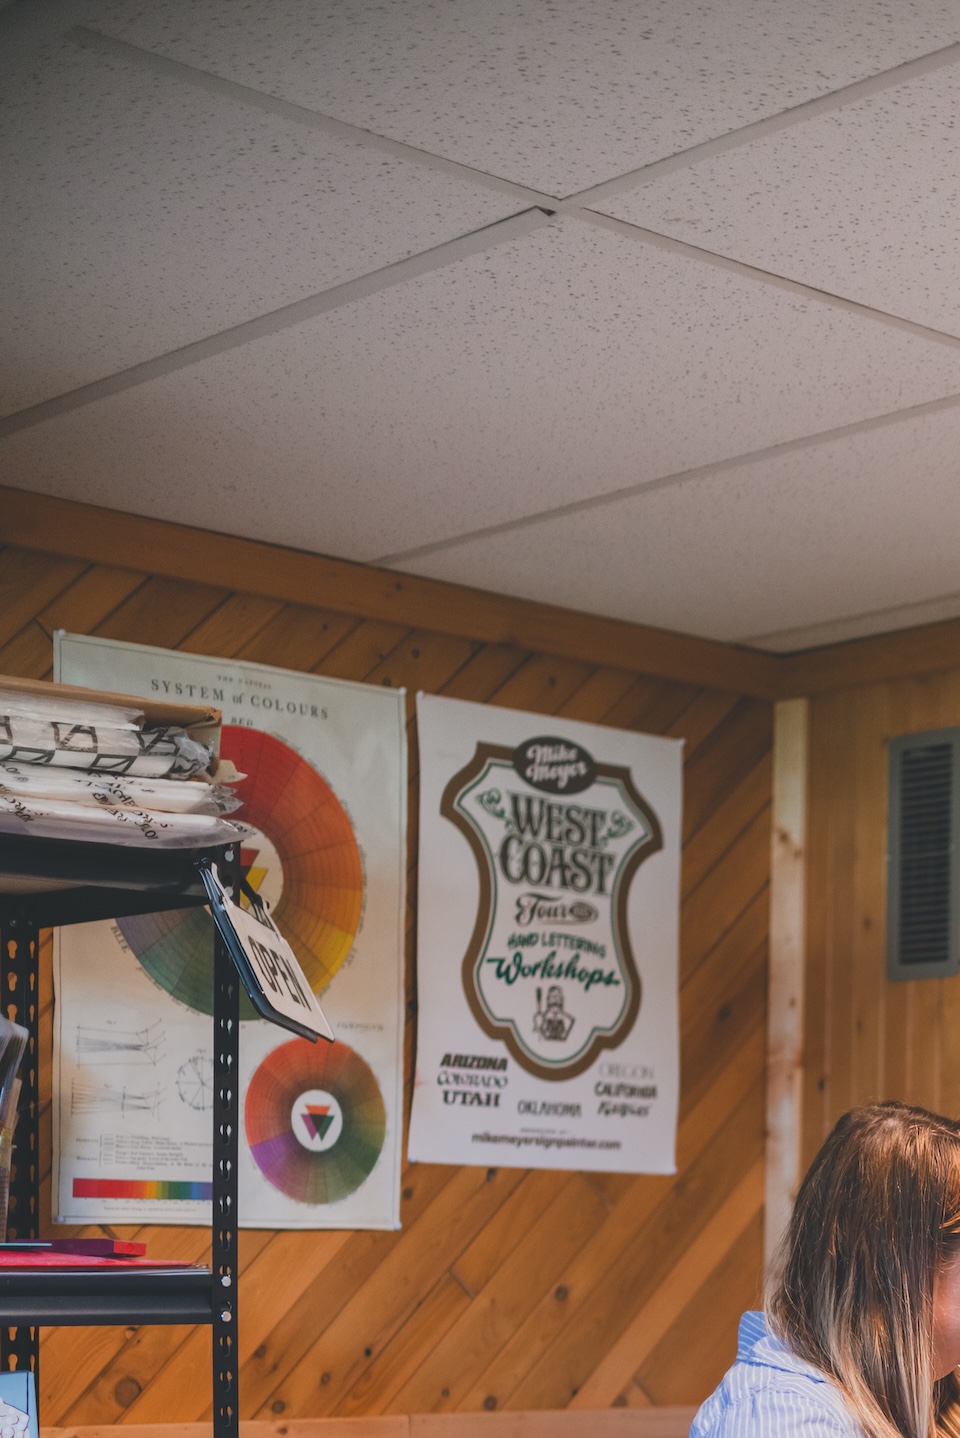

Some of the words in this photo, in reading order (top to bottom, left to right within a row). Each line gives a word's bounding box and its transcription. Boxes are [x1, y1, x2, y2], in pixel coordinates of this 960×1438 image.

[151, 678, 224, 701] SYSTEM
[232, 692, 243, 705] of
[250, 695, 329, 720] COLOURS
[526, 743, 579, 764] Mike
[526, 760, 589, 789] Meyer
[508, 790, 608, 848] WEST
[500, 833, 617, 896] COAST
[247, 935, 312, 1013] OPEN
[486, 951, 620, 992] Workshops
[440, 1053, 508, 1072] ARIZONA
[437, 1070, 508, 1090] COLORADO
[594, 1082, 658, 1099] CALIFORNIA
[442, 1089, 501, 1108] UTAH
[517, 1098, 582, 1118] OKLAHOMA
[471, 1131, 622, 1151] mikemeyersignpainter.com
